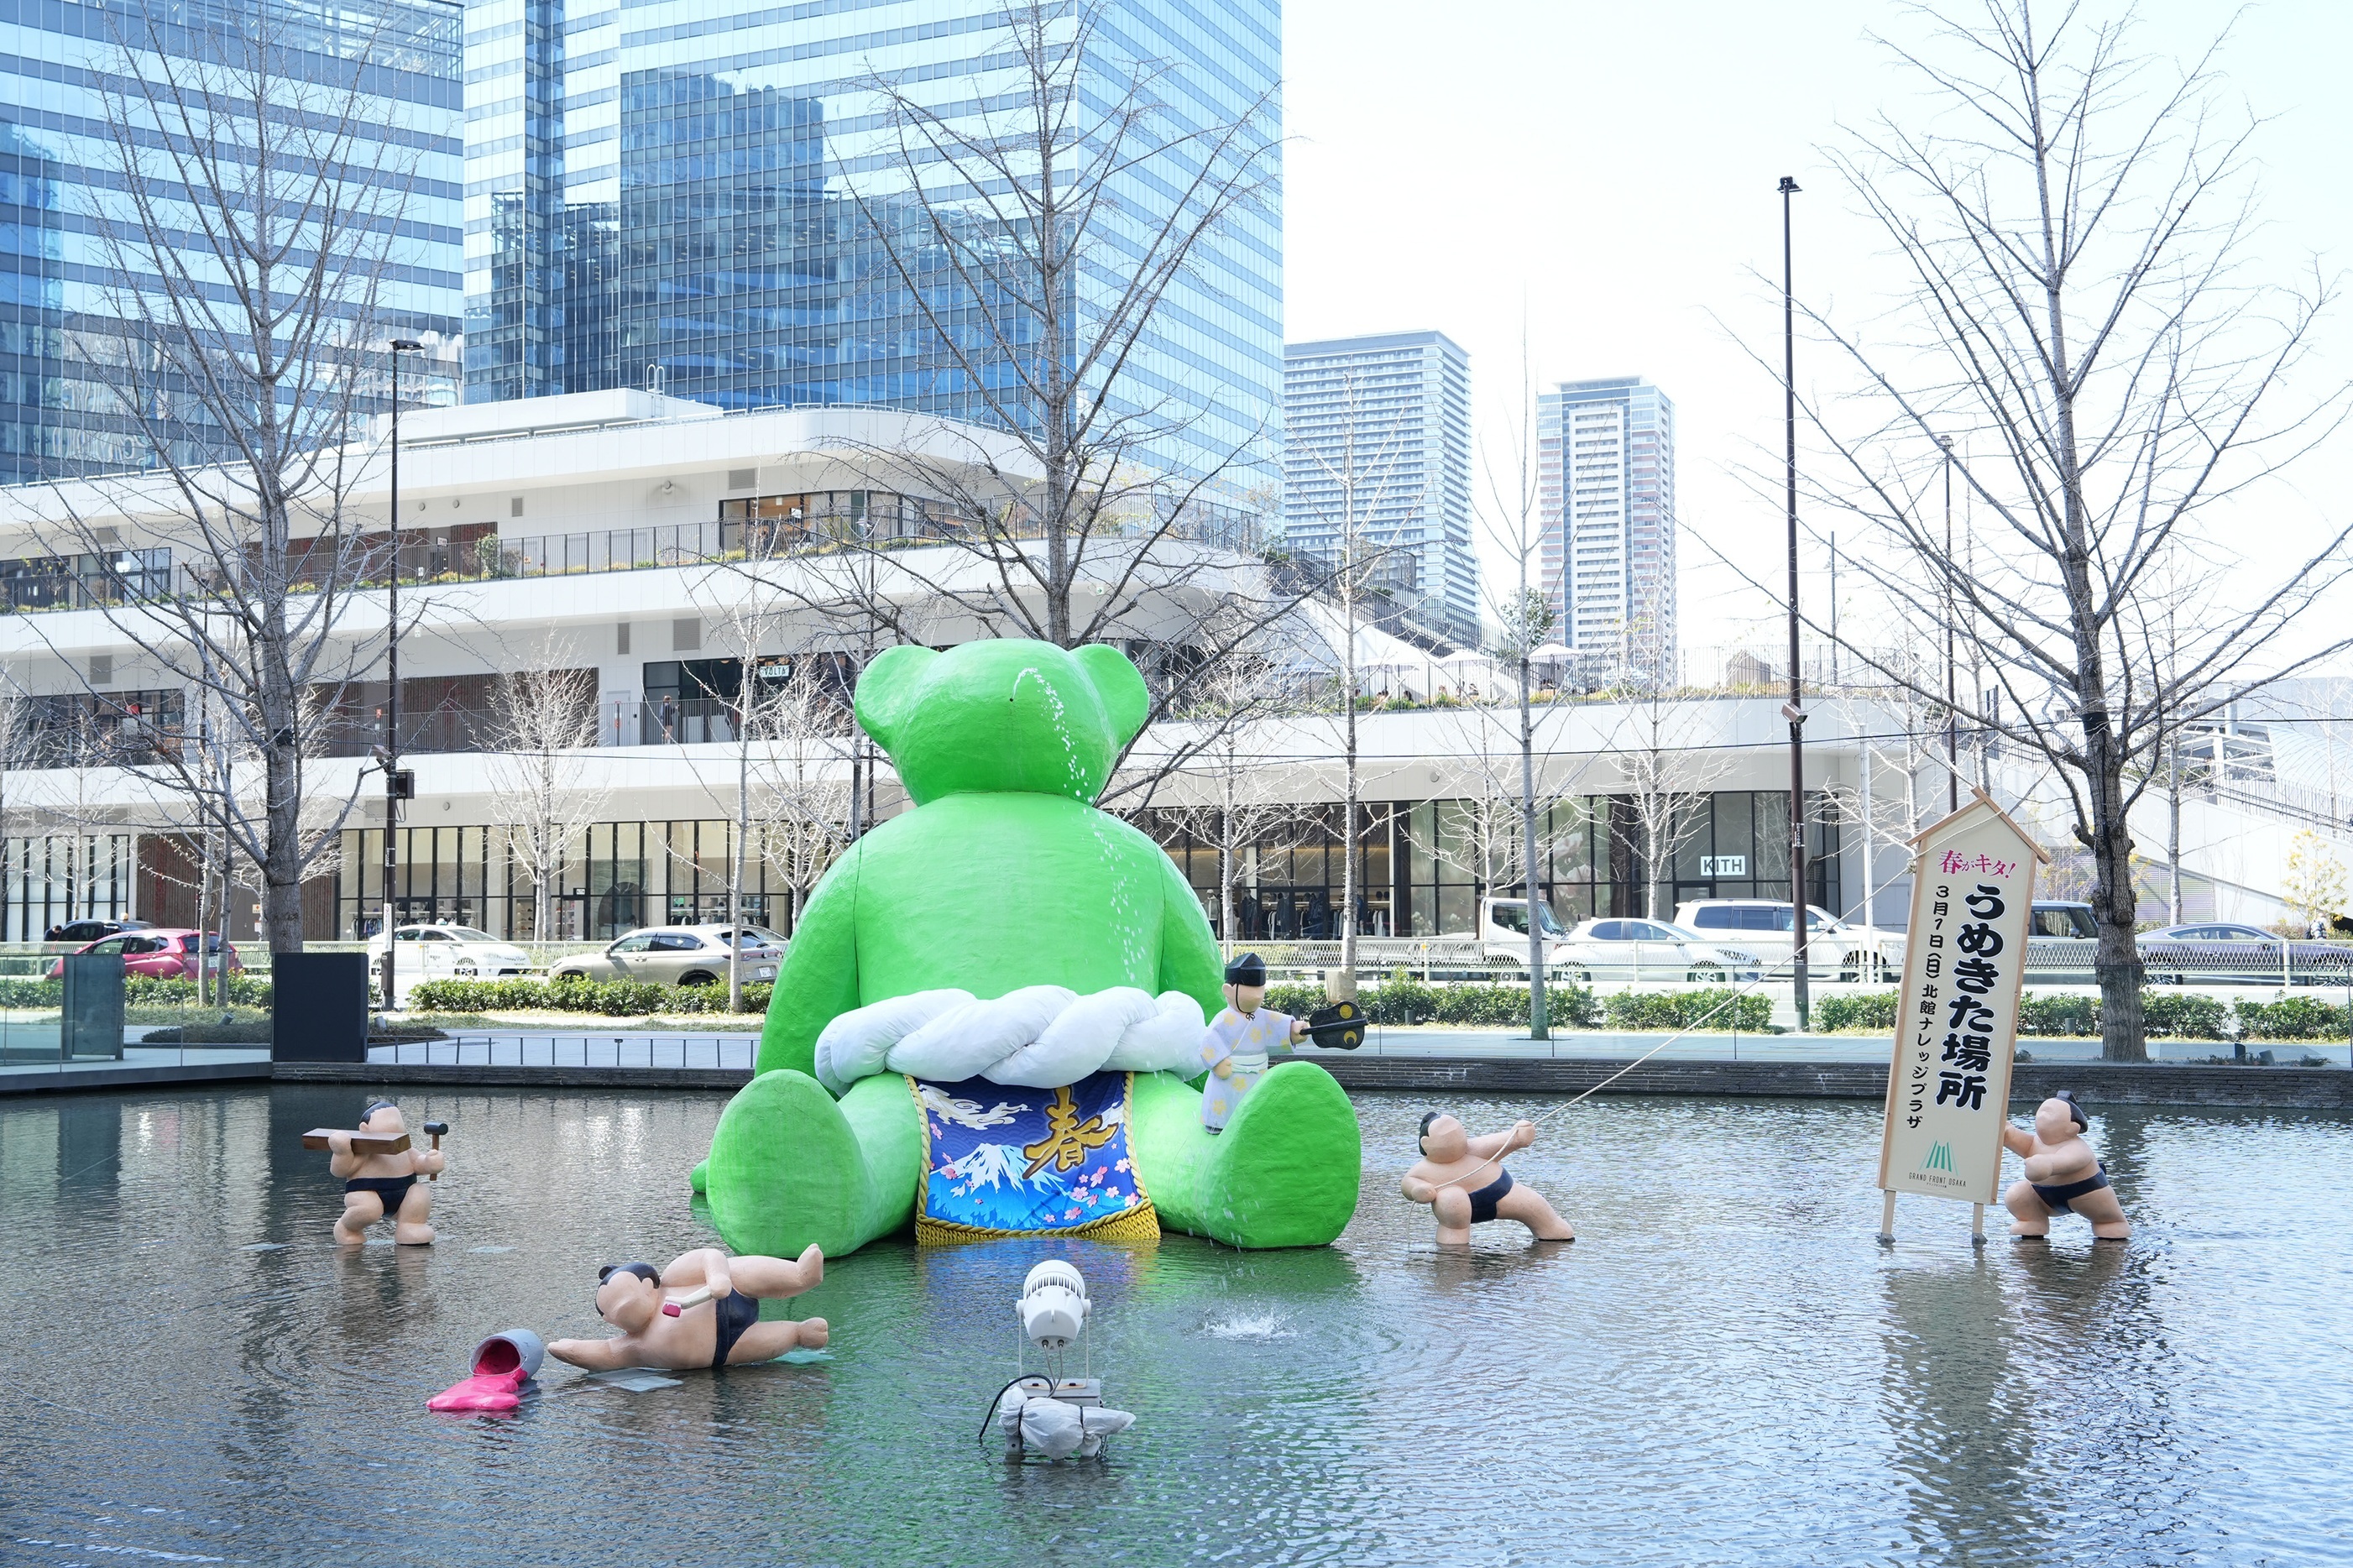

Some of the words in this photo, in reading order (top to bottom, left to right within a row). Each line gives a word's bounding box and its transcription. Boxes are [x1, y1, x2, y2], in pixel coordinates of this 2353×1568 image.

[765, 666, 786, 676] VOLTA
[1703, 859, 1742, 872] KITH
[1937, 849, 2016, 879] 春がキタ!
[1934, 882, 2005, 1111] うめきた場所
[1022, 1085, 1119, 1180] 春
[1908, 1172, 1927, 1182] GRAND
[1928, 1175, 1947, 1184] FRONT
[1948, 1178, 1967, 1188] OSAKA
